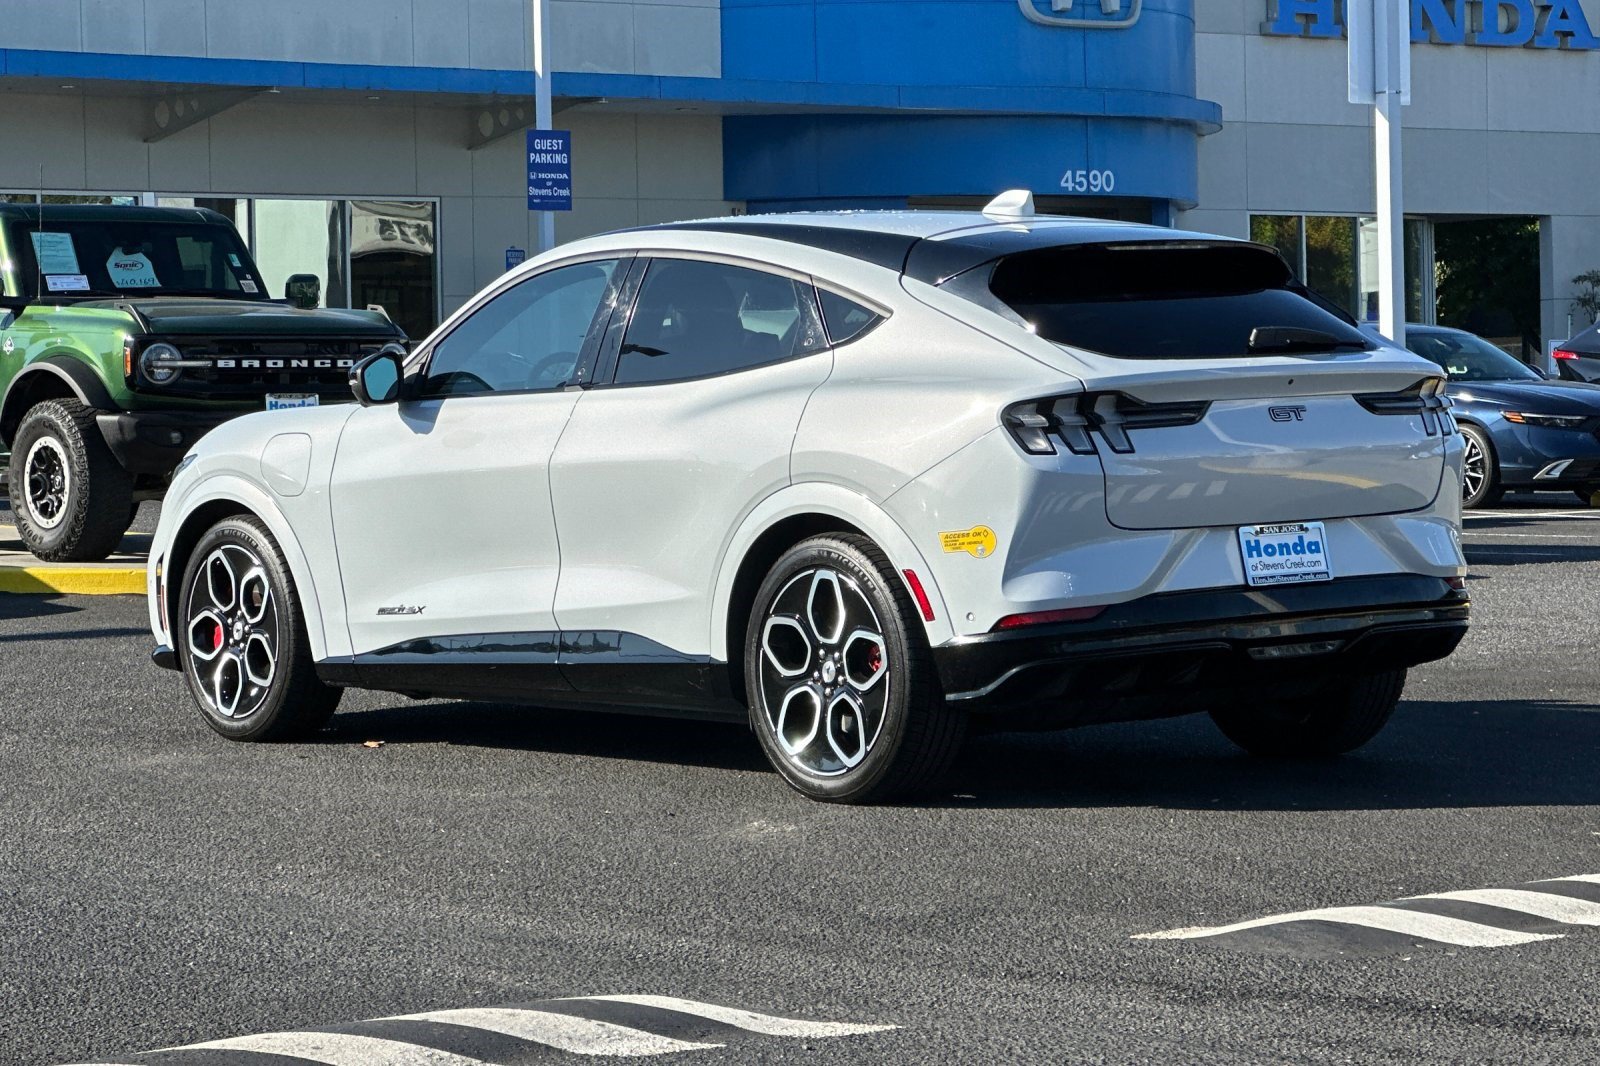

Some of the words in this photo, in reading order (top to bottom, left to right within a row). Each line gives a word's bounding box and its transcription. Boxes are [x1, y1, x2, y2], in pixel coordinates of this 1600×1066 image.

[1264, 0, 1600, 49] HNDA
[534, 139, 563, 150] GUEST
[530, 153, 568, 164] PARKING
[1060, 169, 1115, 192] 4590
[528, 186, 552, 196] Stevens
[553, 187, 570, 197] Creek
[113, 261, 140, 269] Sonic
[217, 359, 354, 368] BRONCO
[1268, 405, 1307, 422] GT
[1263, 525, 1280, 534] SAN
[1281, 524, 1300, 533] JOSE
[1245, 535, 1322, 558] Honda
[831, 551, 874, 589] MICHELIN
[1251, 564, 1259, 572] of
[1259, 560, 1285, 571] Stevens
[1285, 557, 1322, 568] Creek.com
